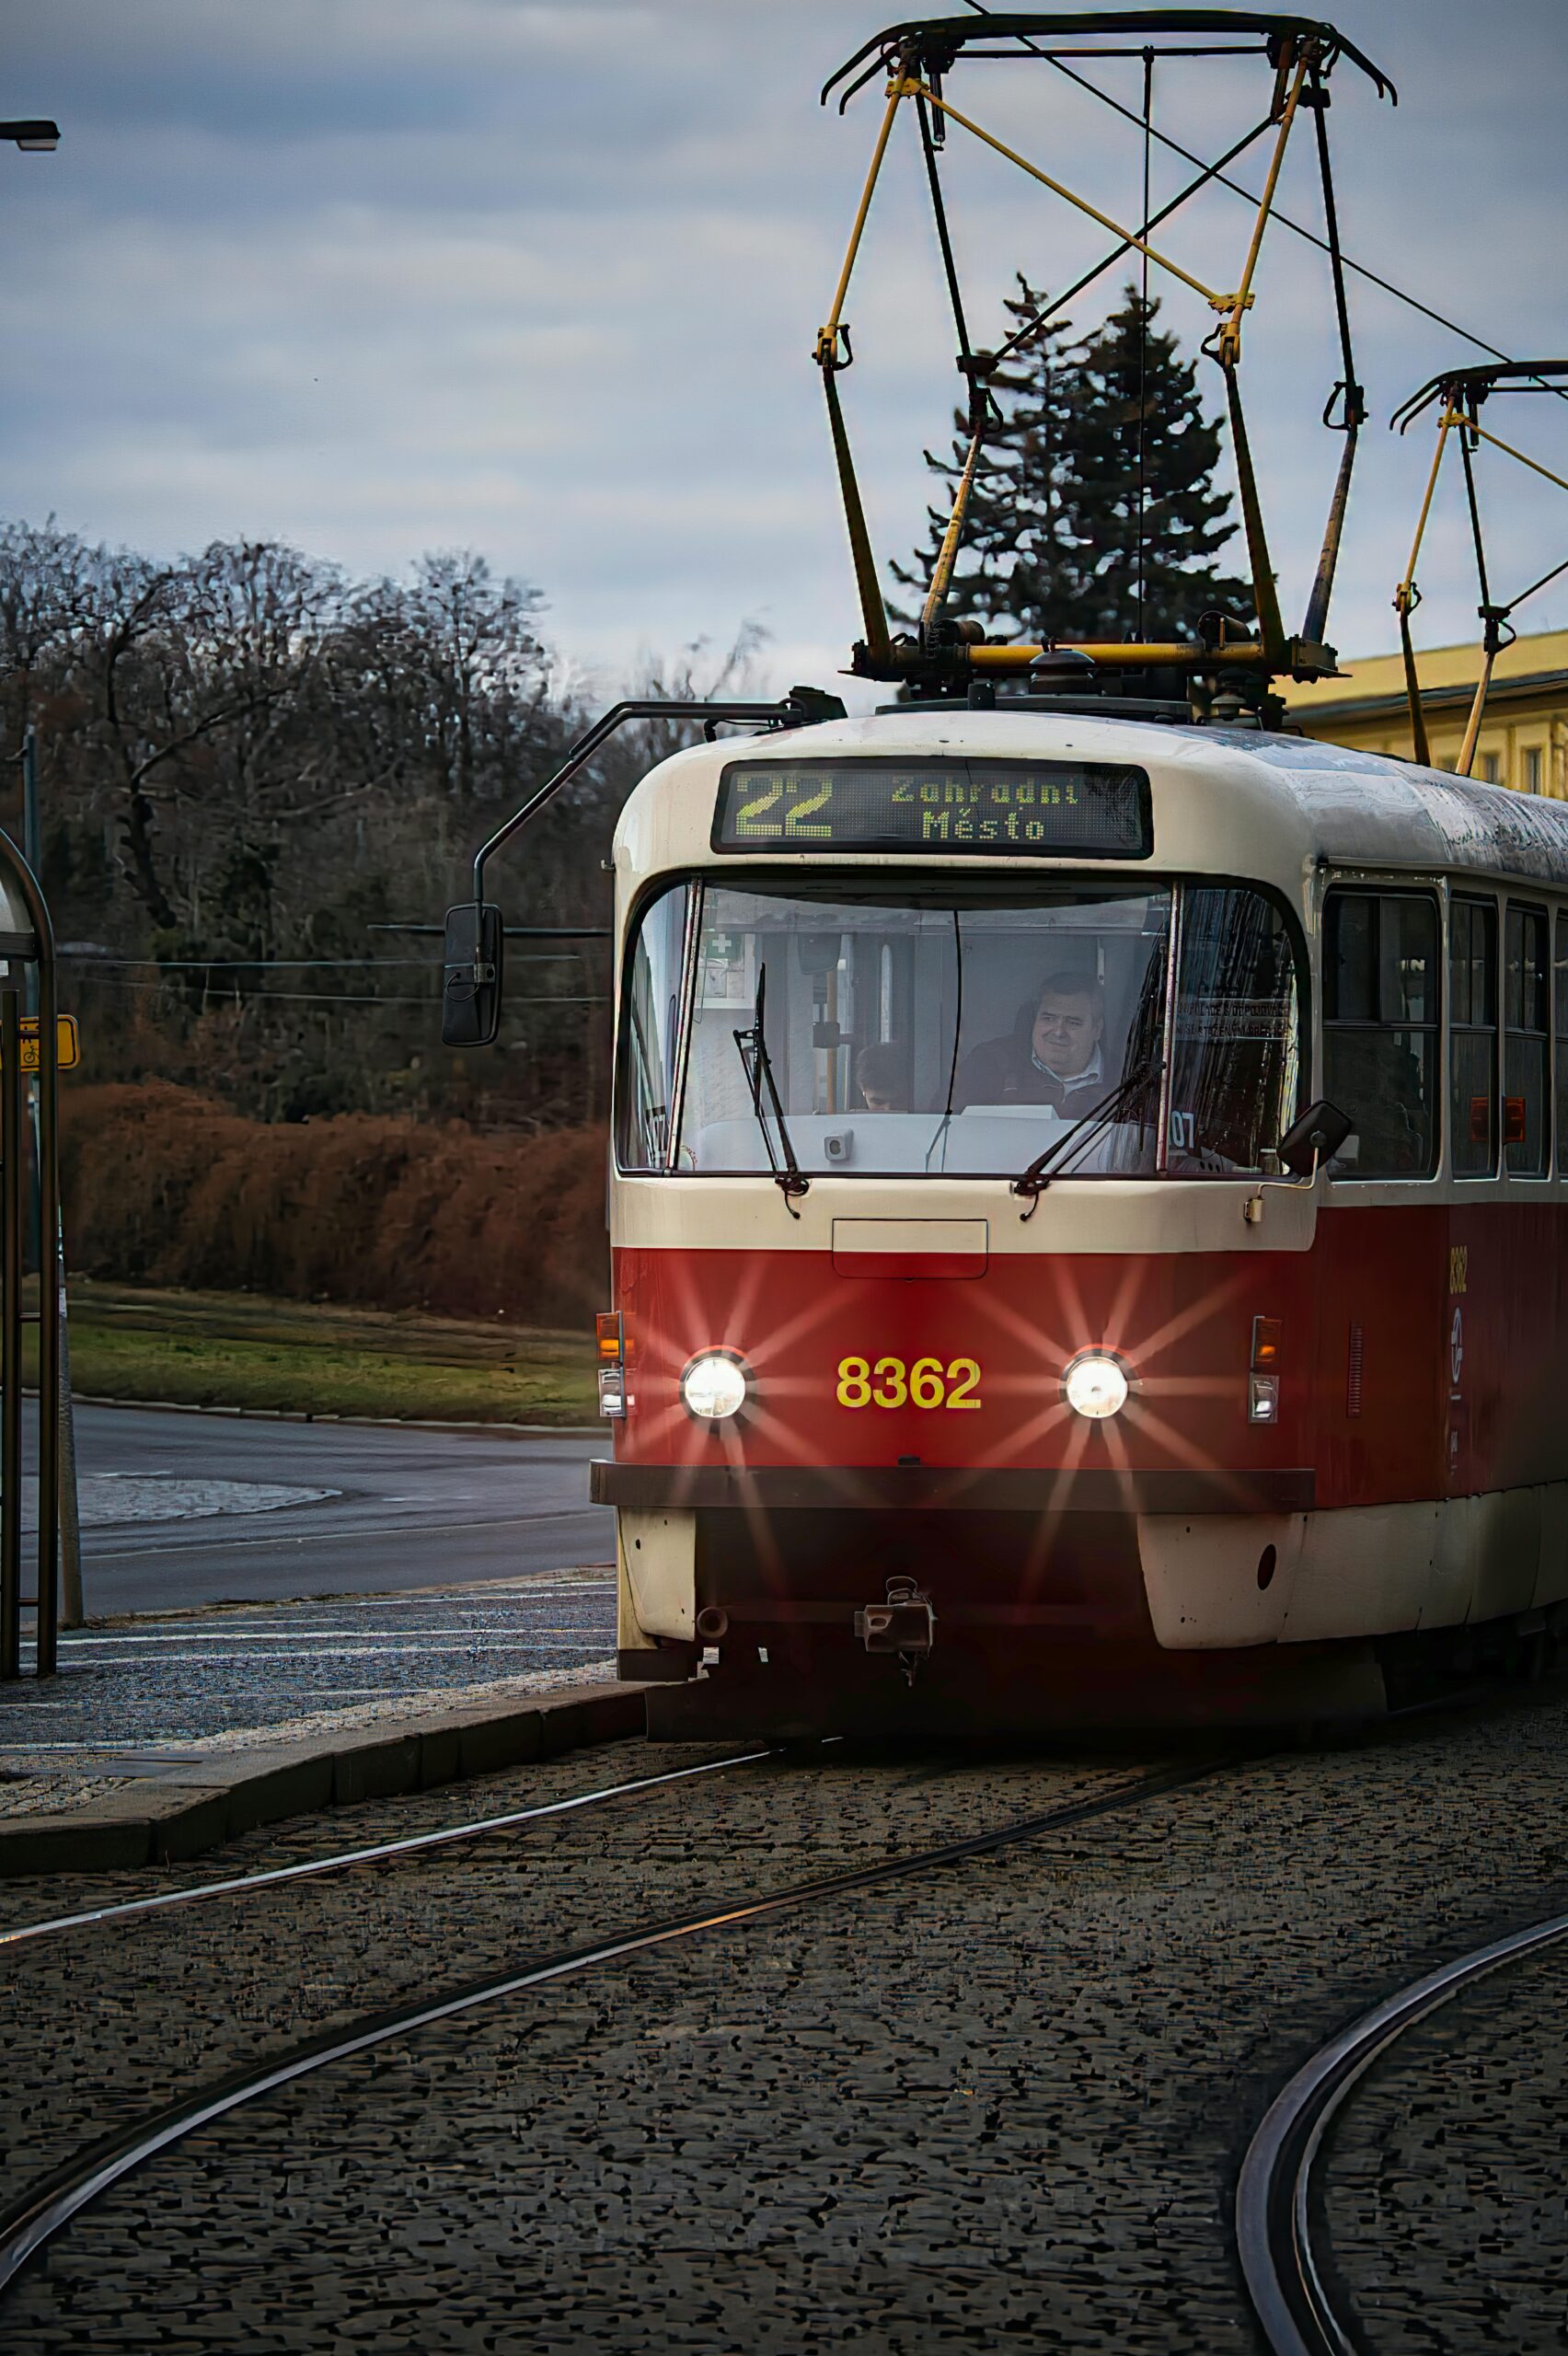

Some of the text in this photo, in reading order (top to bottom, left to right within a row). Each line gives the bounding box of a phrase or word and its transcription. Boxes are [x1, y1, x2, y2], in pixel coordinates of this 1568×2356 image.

[736, 773, 833, 837] 22
[923, 808, 1045, 840] Město
[836, 1357, 982, 1409] 8362
